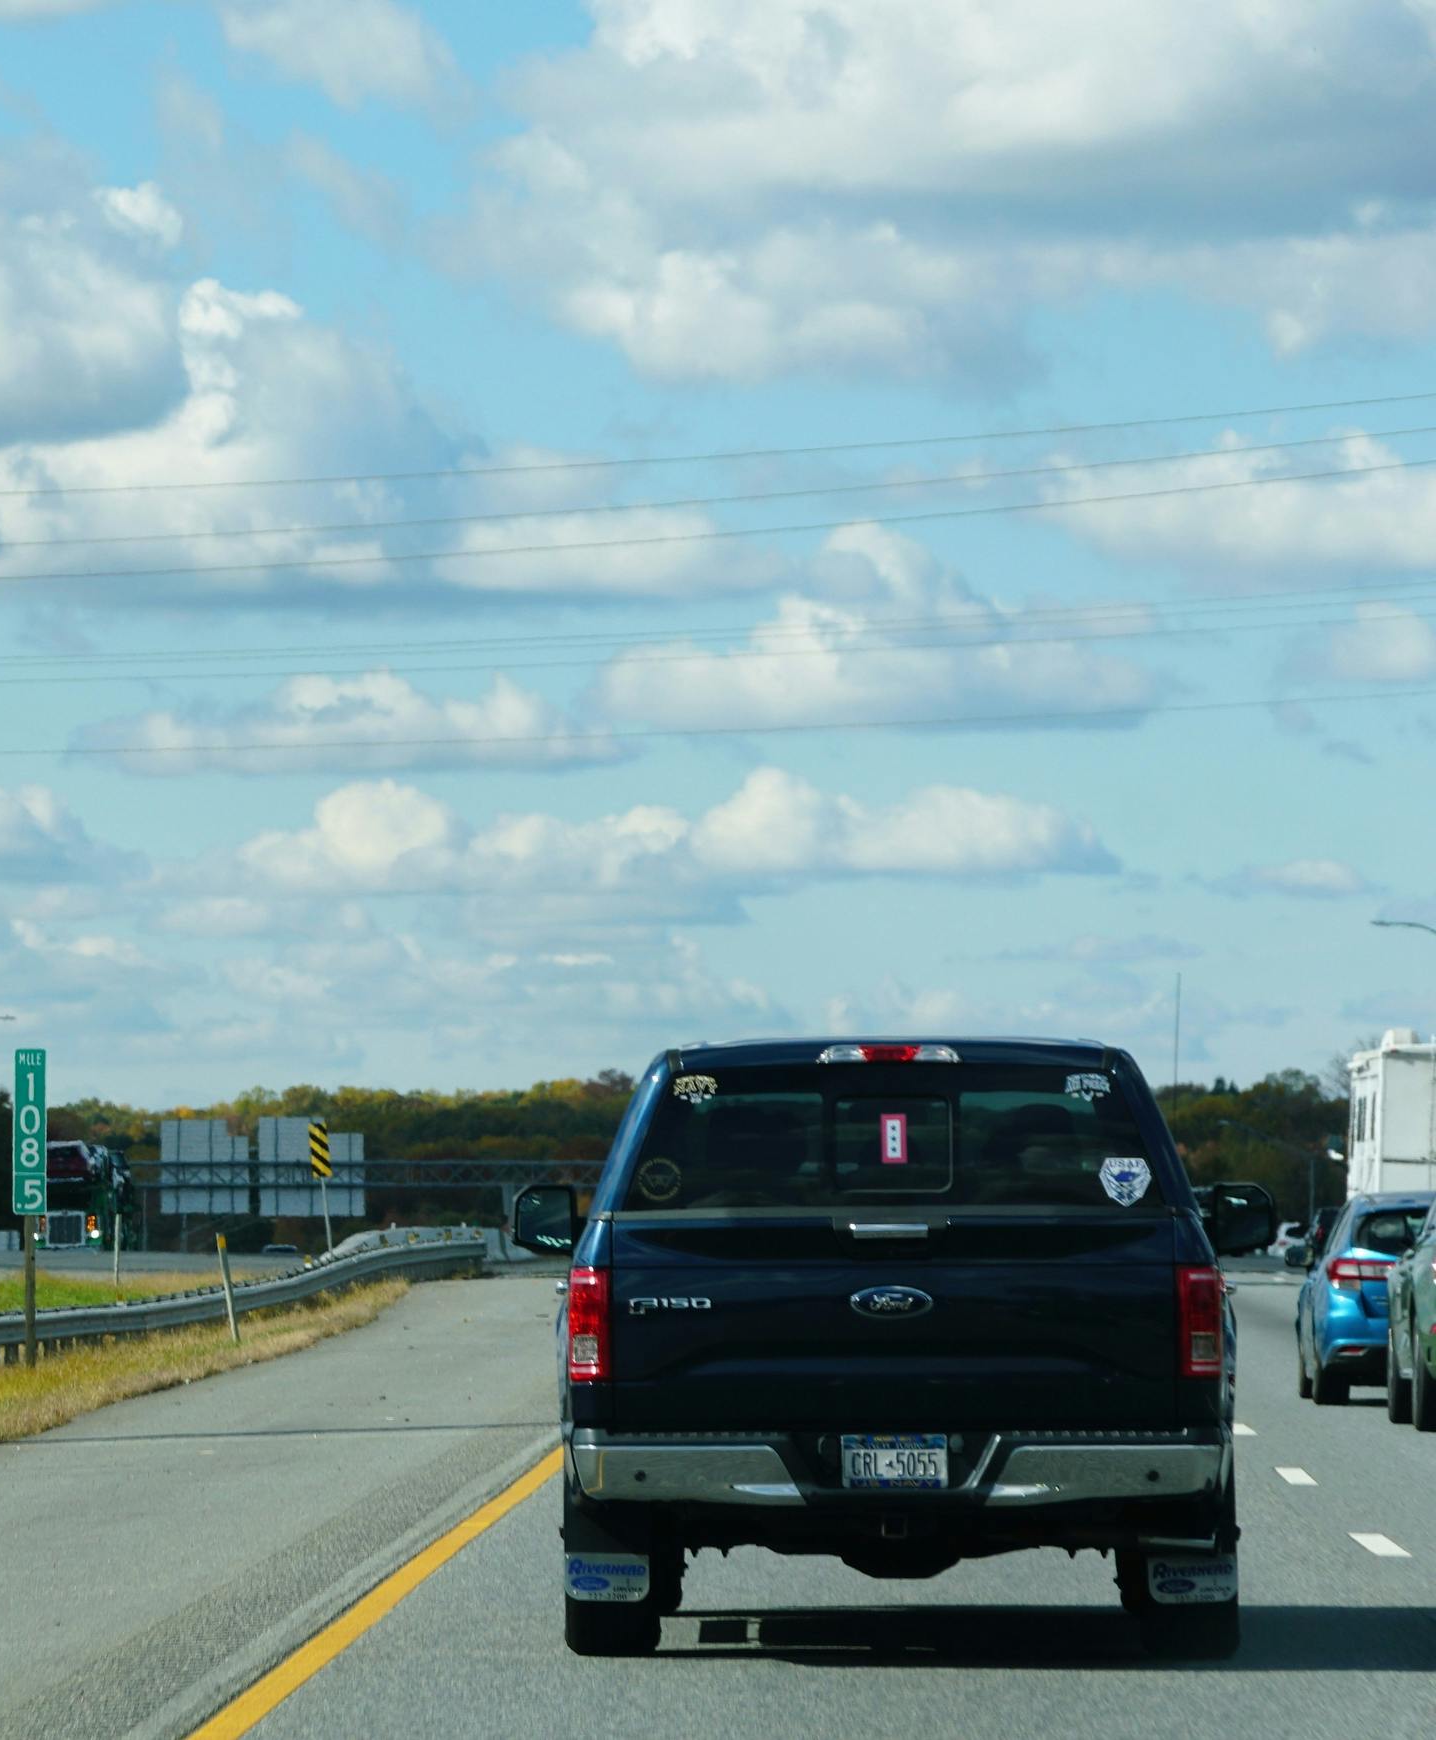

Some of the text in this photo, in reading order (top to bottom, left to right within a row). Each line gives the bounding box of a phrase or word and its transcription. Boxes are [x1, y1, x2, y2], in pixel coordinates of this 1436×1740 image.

[19, 1052, 42, 1066] MILE
[851, 1451, 938, 1478] CRL 5055
